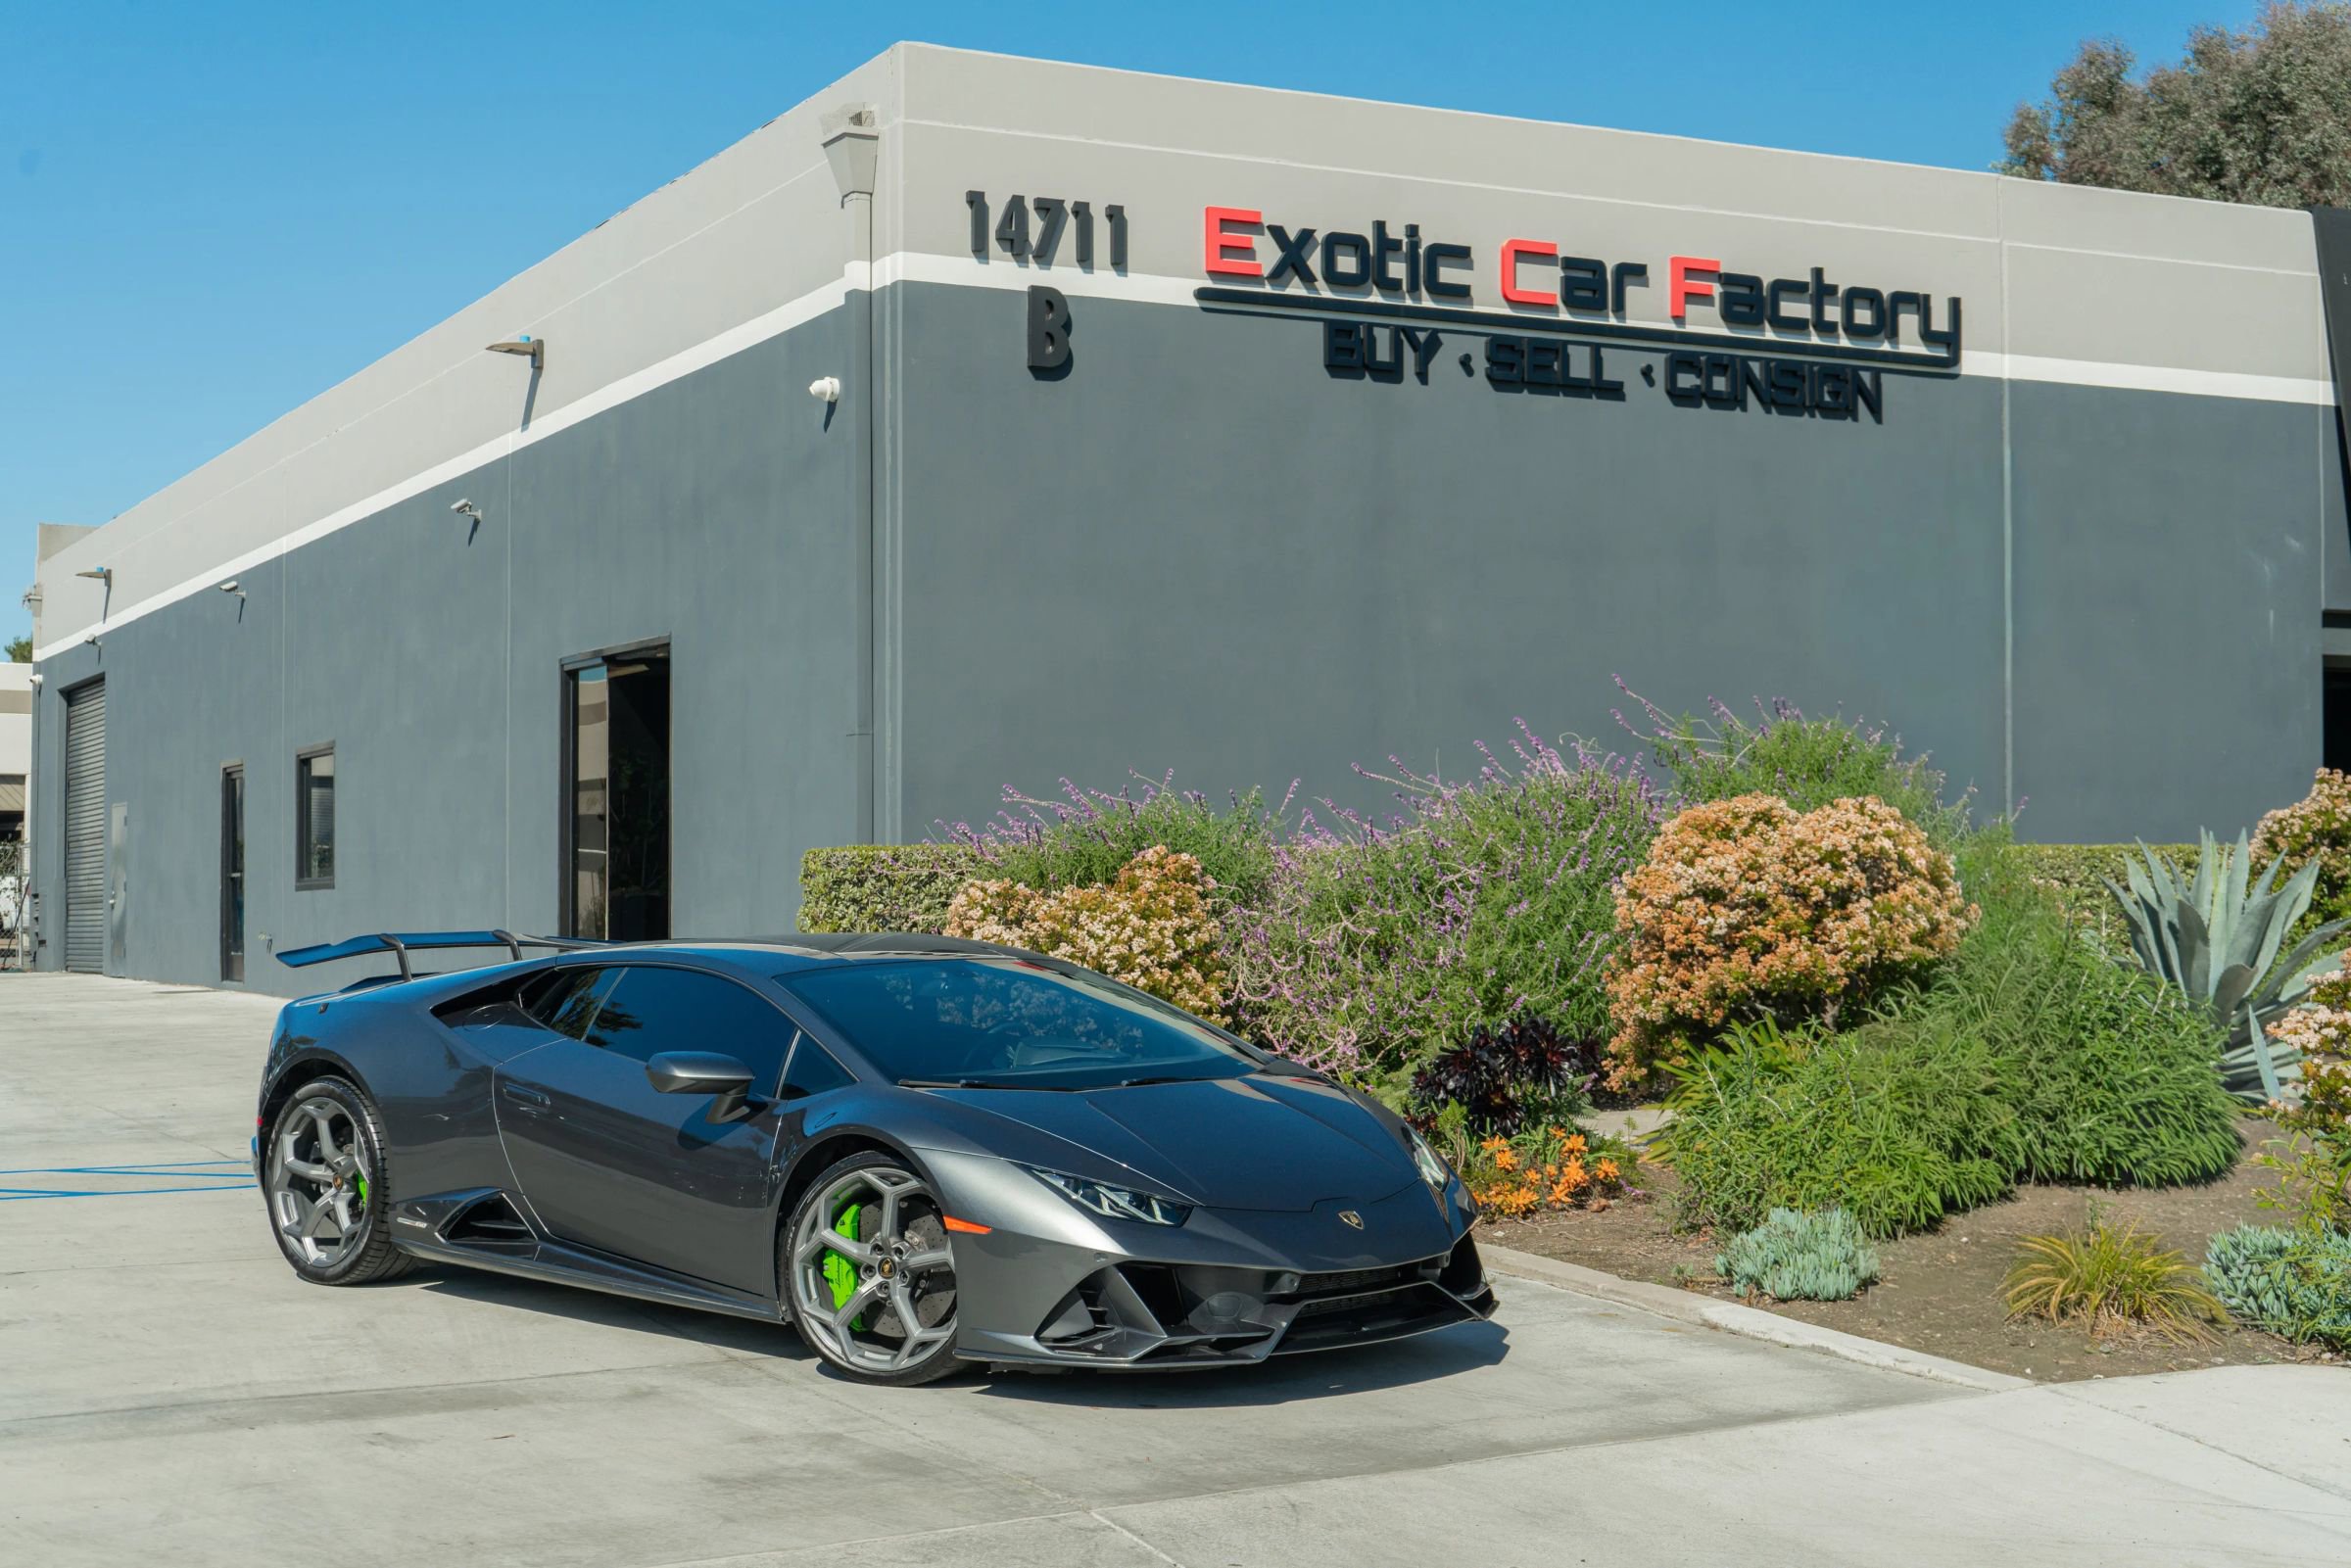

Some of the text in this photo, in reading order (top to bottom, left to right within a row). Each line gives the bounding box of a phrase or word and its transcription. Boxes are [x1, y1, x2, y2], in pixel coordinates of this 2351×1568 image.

[966, 190, 1126, 264] 14711
[1028, 285, 1070, 369] B
[1205, 206, 1961, 368] Exotic Car Factory
[1324, 321, 1883, 422] BUY SELL CONSIGN
